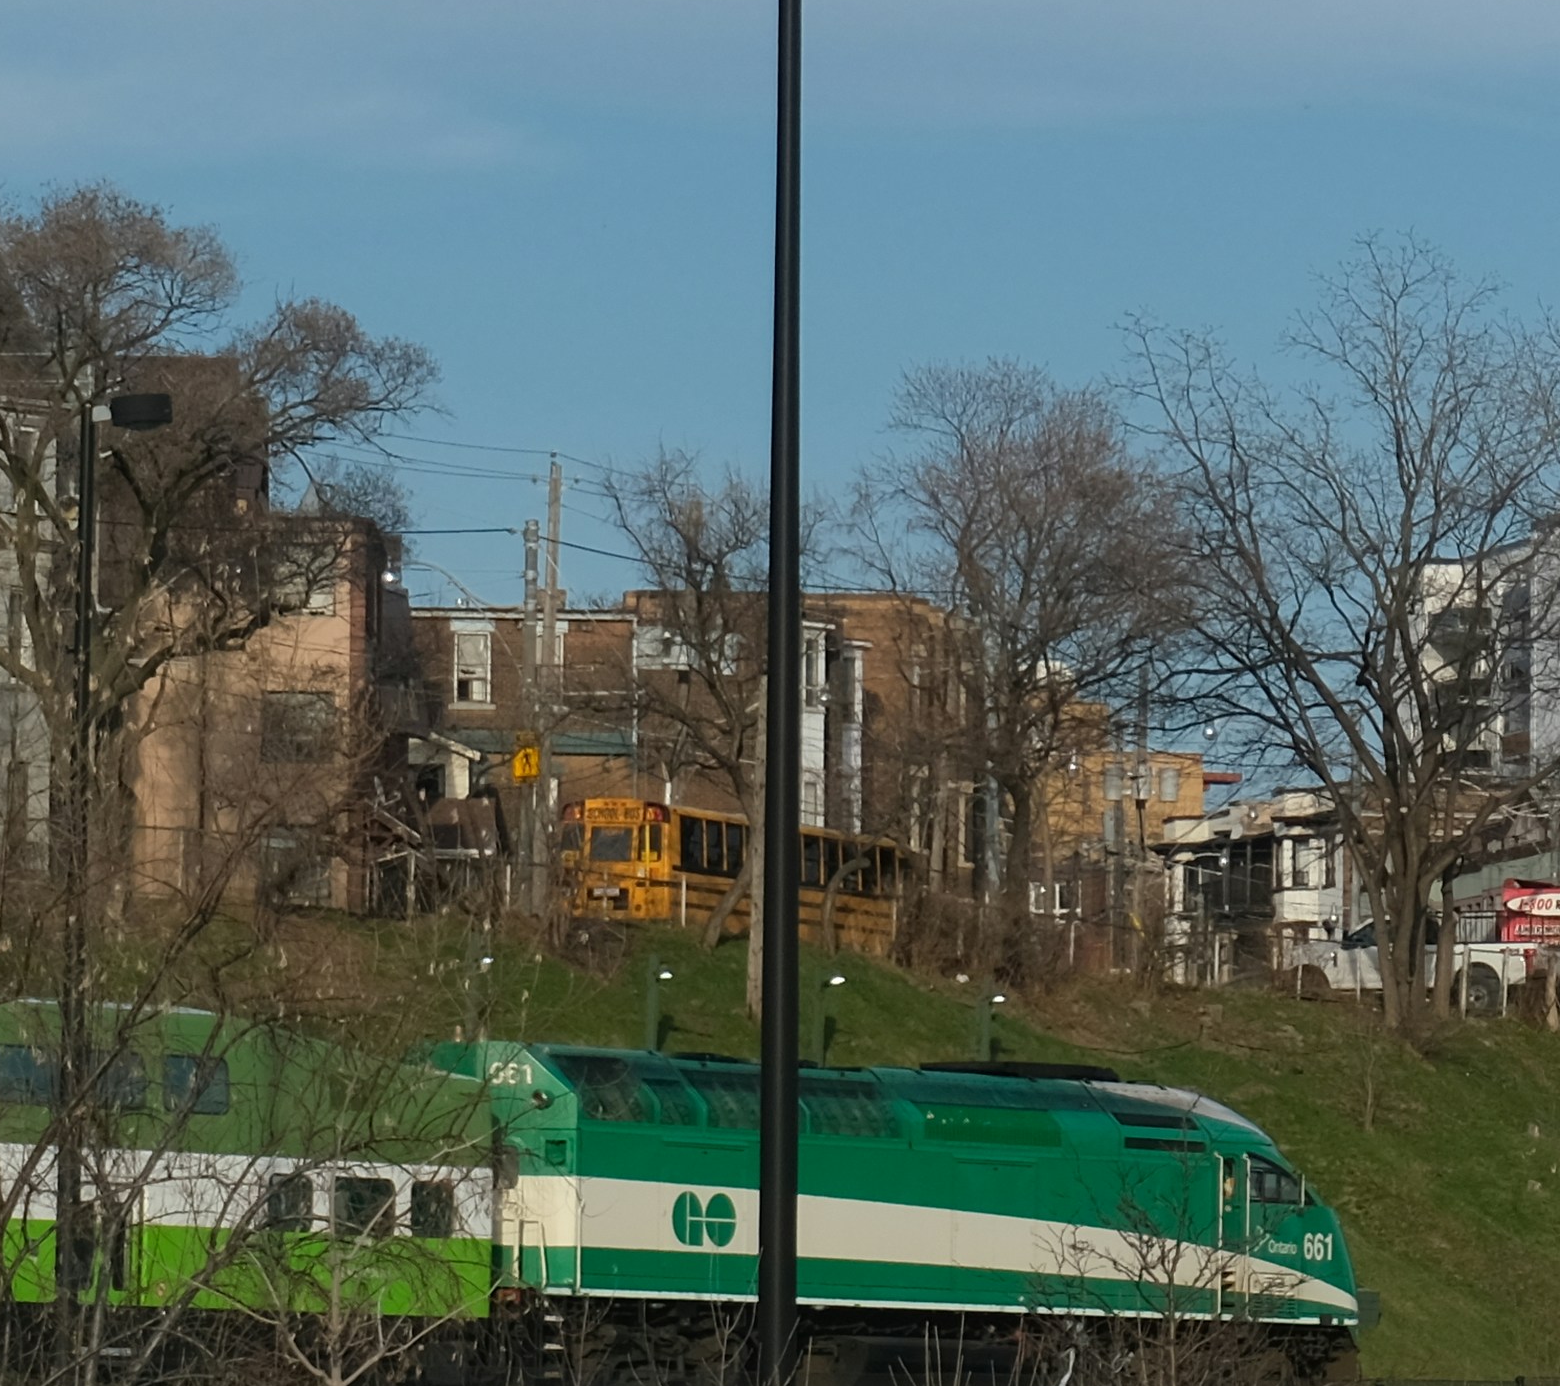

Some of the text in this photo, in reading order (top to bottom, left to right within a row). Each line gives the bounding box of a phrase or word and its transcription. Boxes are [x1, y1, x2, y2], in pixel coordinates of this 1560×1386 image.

[587, 808, 641, 820] SCHOOL BUS
[489, 1061, 533, 1085] 661
[672, 1191, 737, 1247] GO
[1268, 1239, 1297, 1254] Ontario
[1303, 1232, 1333, 1261] 661
